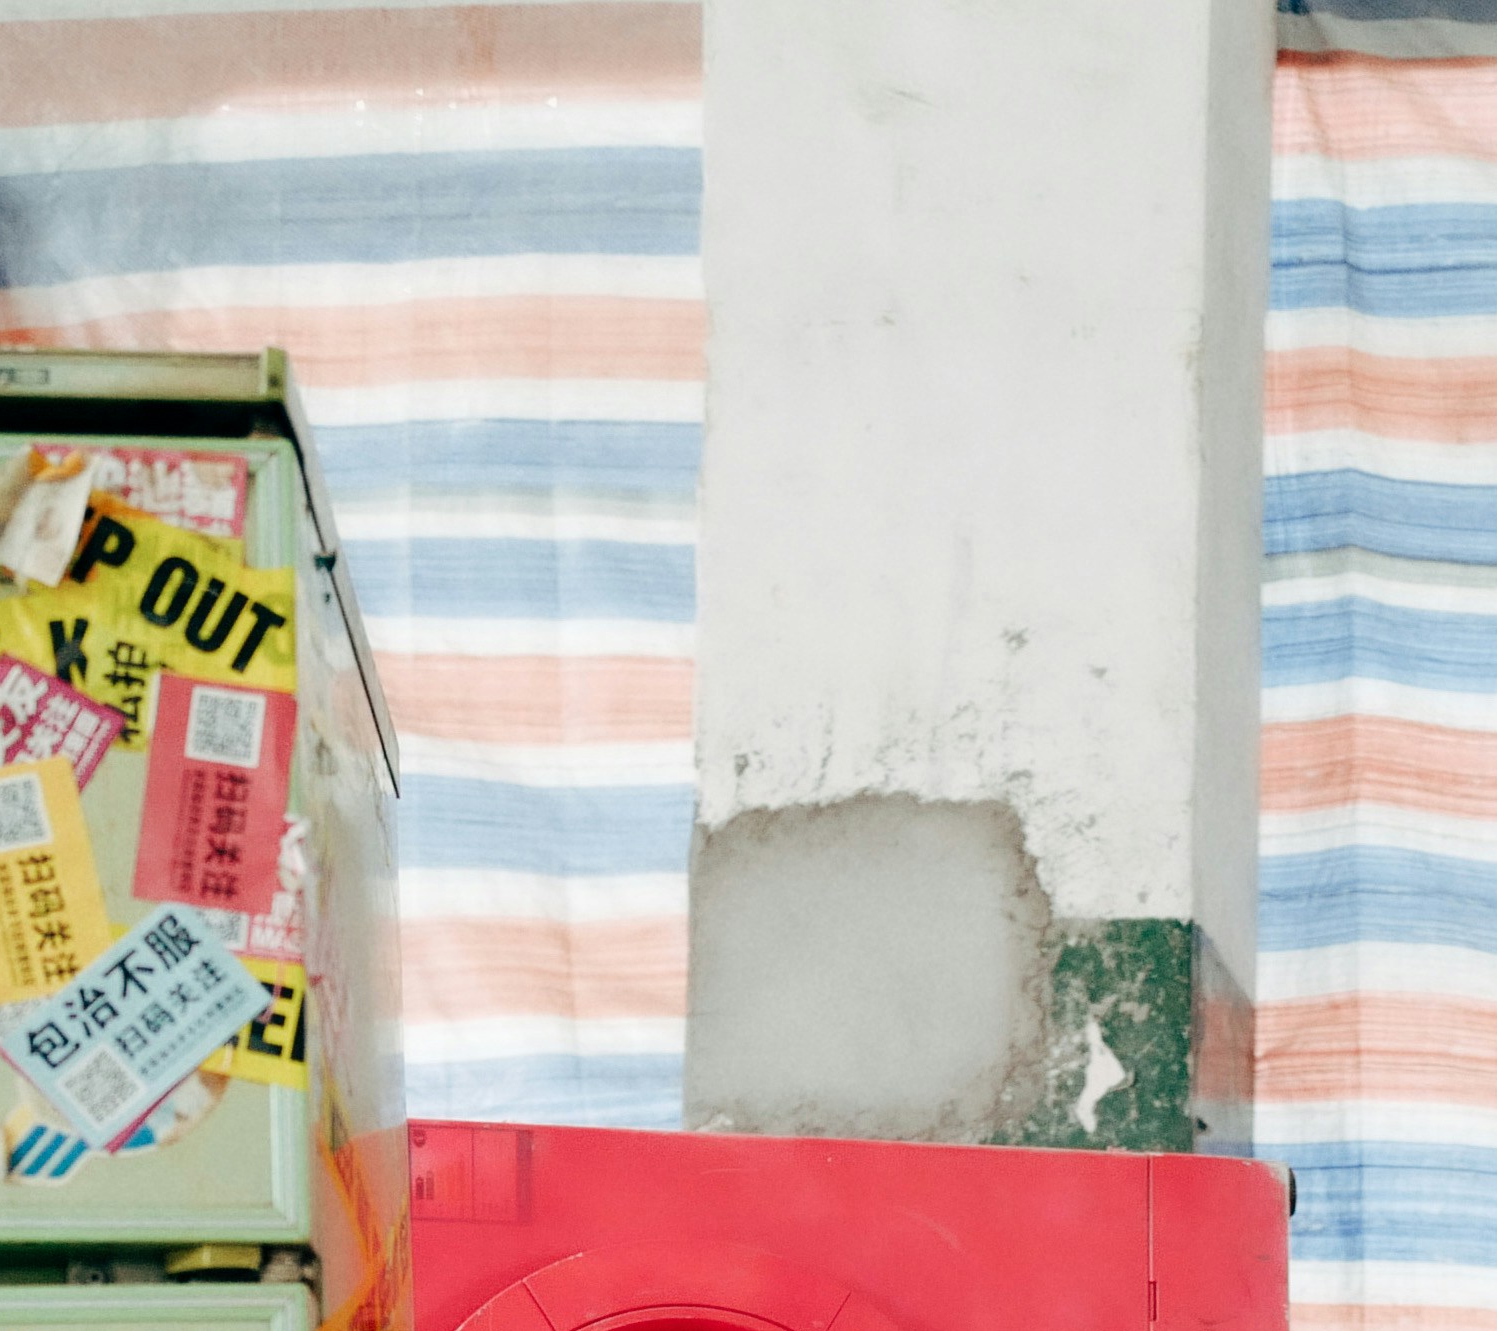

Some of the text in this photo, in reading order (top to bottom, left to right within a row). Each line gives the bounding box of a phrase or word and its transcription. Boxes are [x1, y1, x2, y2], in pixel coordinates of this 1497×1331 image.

[139, 556, 286, 674] OUT
[203, 770, 252, 901] 扫码关注
[16, 851, 81, 985] 扫码关注
[26, 912, 200, 1069] 包治不服
[114, 957, 228, 1059] 扫码关注
